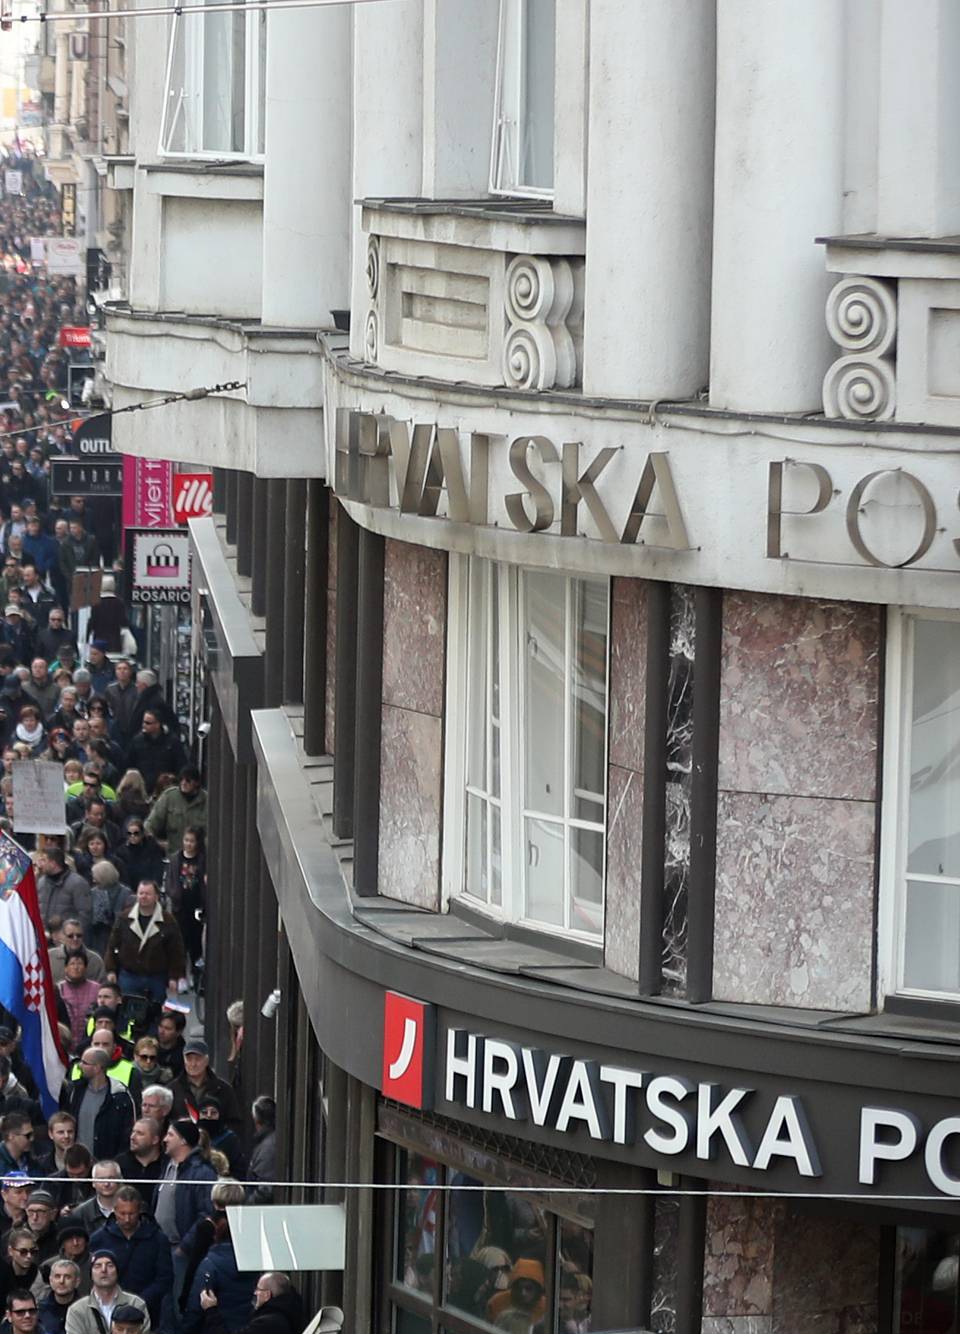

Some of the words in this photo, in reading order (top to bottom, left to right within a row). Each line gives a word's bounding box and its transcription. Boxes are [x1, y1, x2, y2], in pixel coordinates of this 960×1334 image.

[767, 456, 960, 568] PO
[132, 589, 191, 603] ROSARIO
[445, 1027, 824, 1177] HRVATSKA
